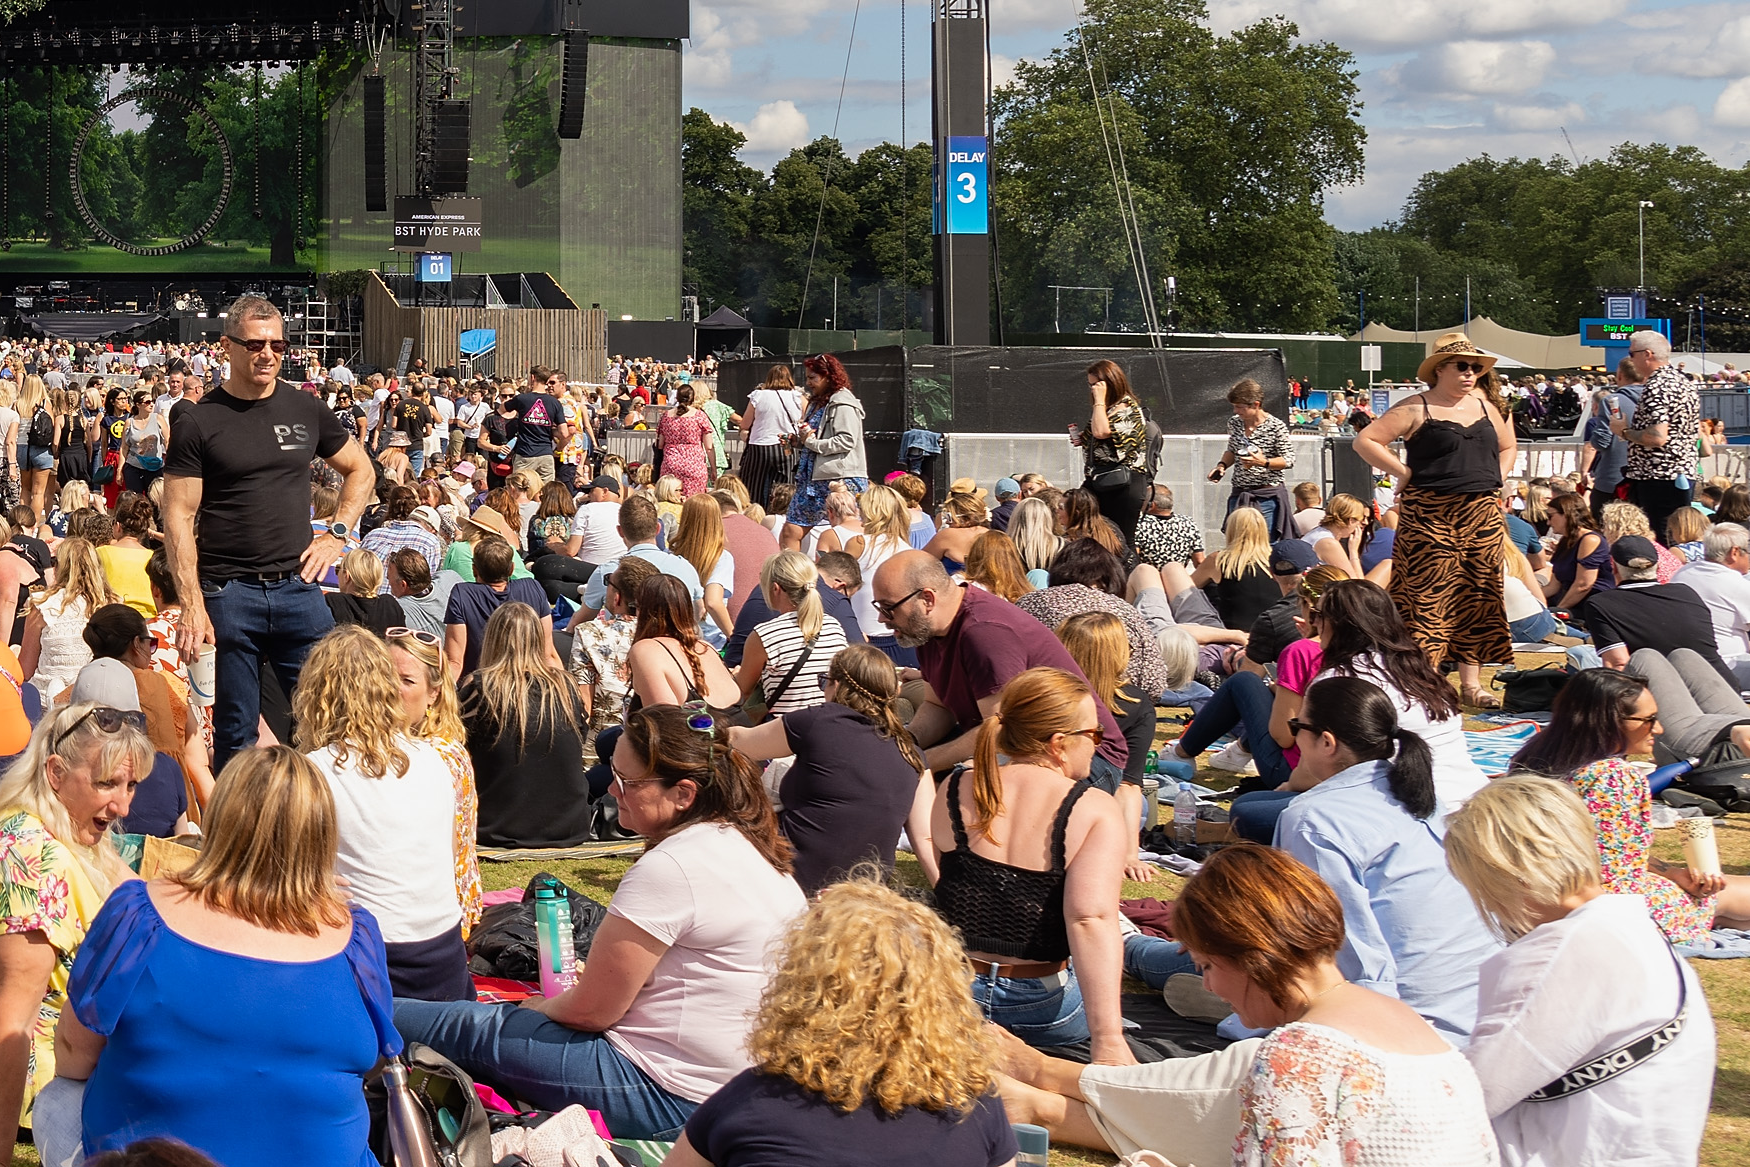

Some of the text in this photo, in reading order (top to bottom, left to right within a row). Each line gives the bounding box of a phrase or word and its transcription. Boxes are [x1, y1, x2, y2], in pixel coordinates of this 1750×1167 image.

[949, 152, 986, 163] DELAY
[956, 172, 977, 204] 3
[395, 226, 481, 237] BST HYDE PARK
[430, 262, 444, 275] 01
[1603, 324, 1634, 332] Stay Cool
[273, 424, 310, 443] PS
[1562, 1049, 1635, 1093] DKNY
